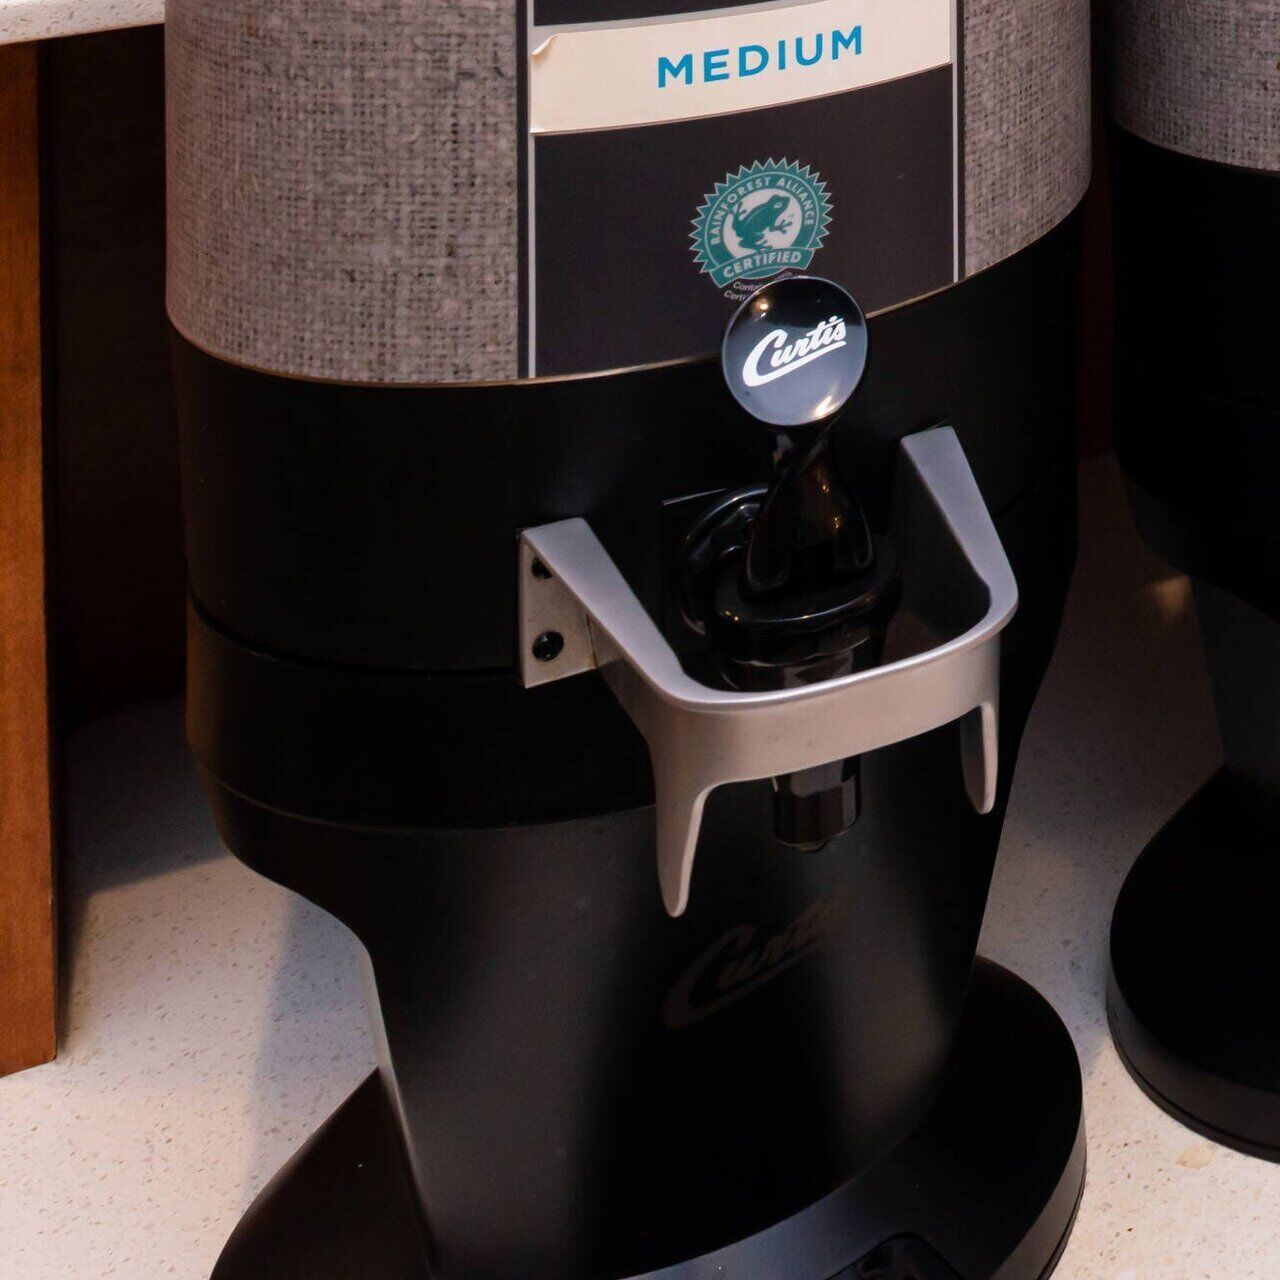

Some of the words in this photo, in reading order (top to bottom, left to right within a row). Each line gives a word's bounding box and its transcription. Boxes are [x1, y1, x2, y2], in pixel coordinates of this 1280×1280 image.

[657, 24, 863, 88] MEDIUM
[710, 176, 771, 246] RAINFOREST
[776, 176, 815, 227] ALLIANCE
[723, 249, 803, 279] CERTIFIED
[742, 315, 847, 387] Curtis
